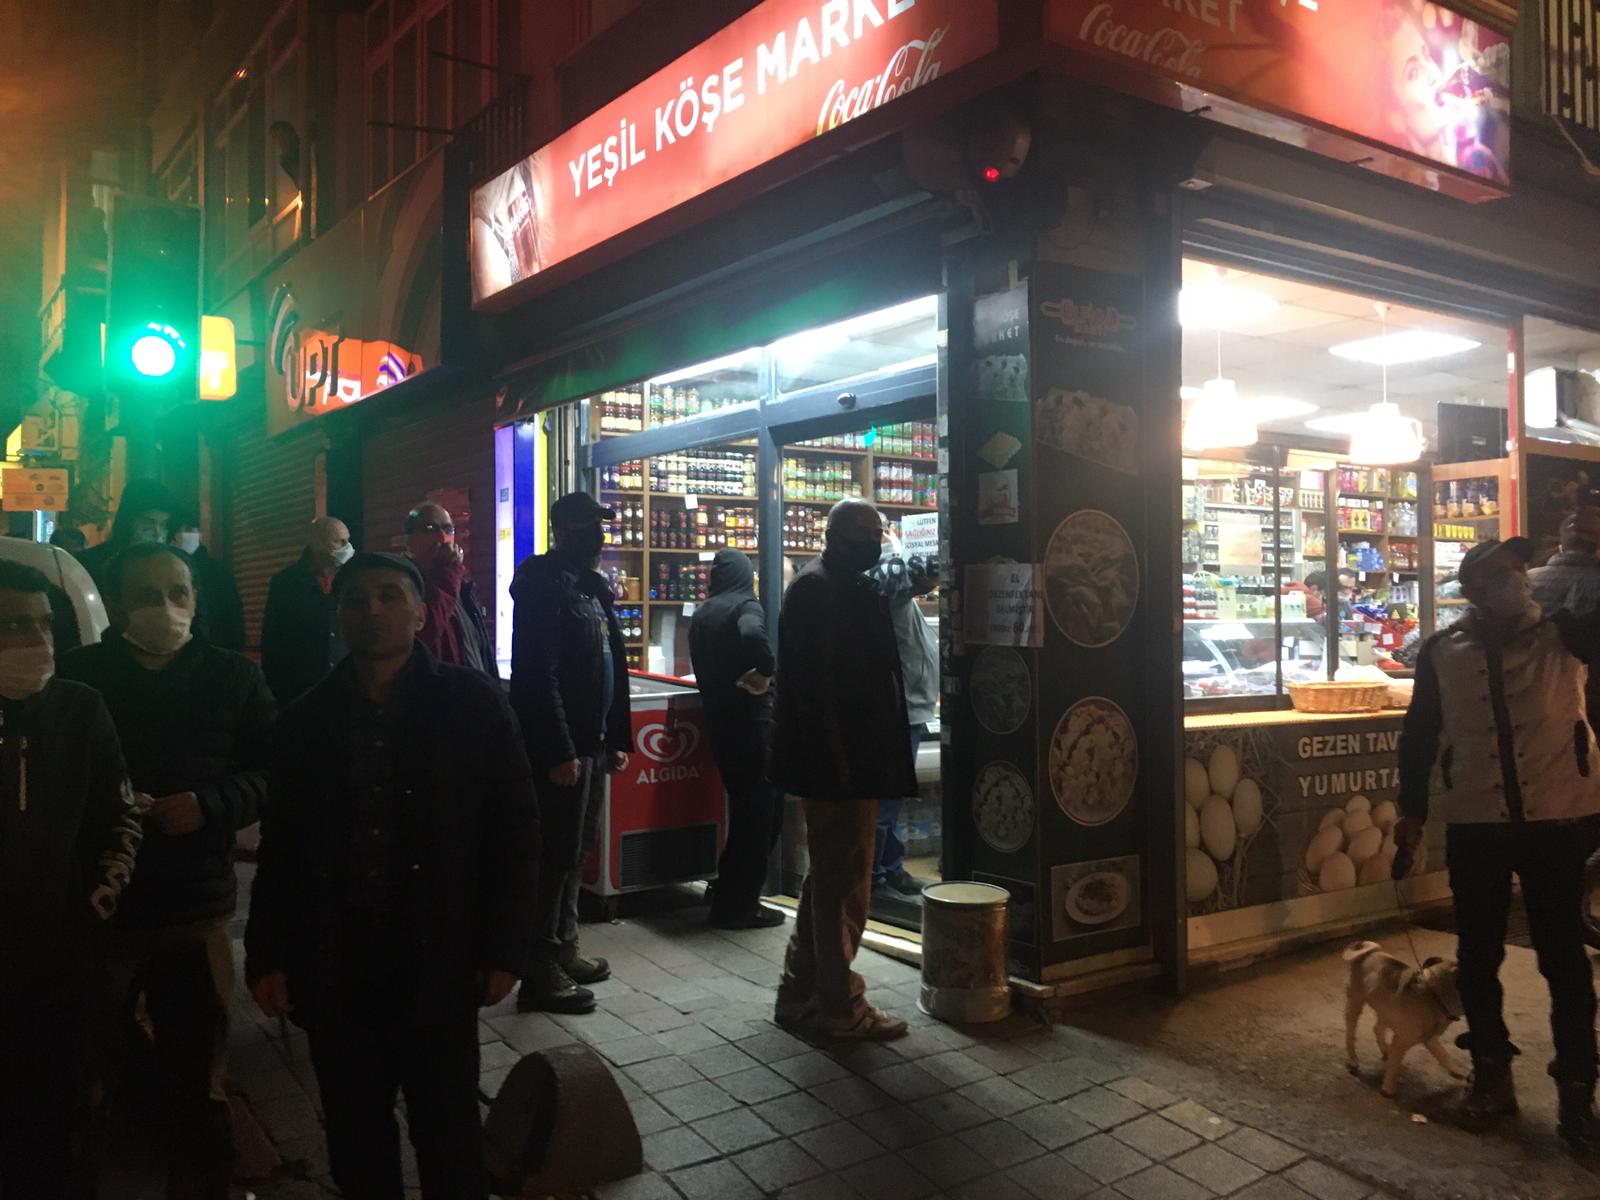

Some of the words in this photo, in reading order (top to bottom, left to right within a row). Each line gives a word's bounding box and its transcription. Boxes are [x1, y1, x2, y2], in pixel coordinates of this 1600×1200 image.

[568, 118, 646, 198] YEŞİL
[655, 57, 745, 152] KÖŞE
[1299, 733, 1361, 758] GEZEN
